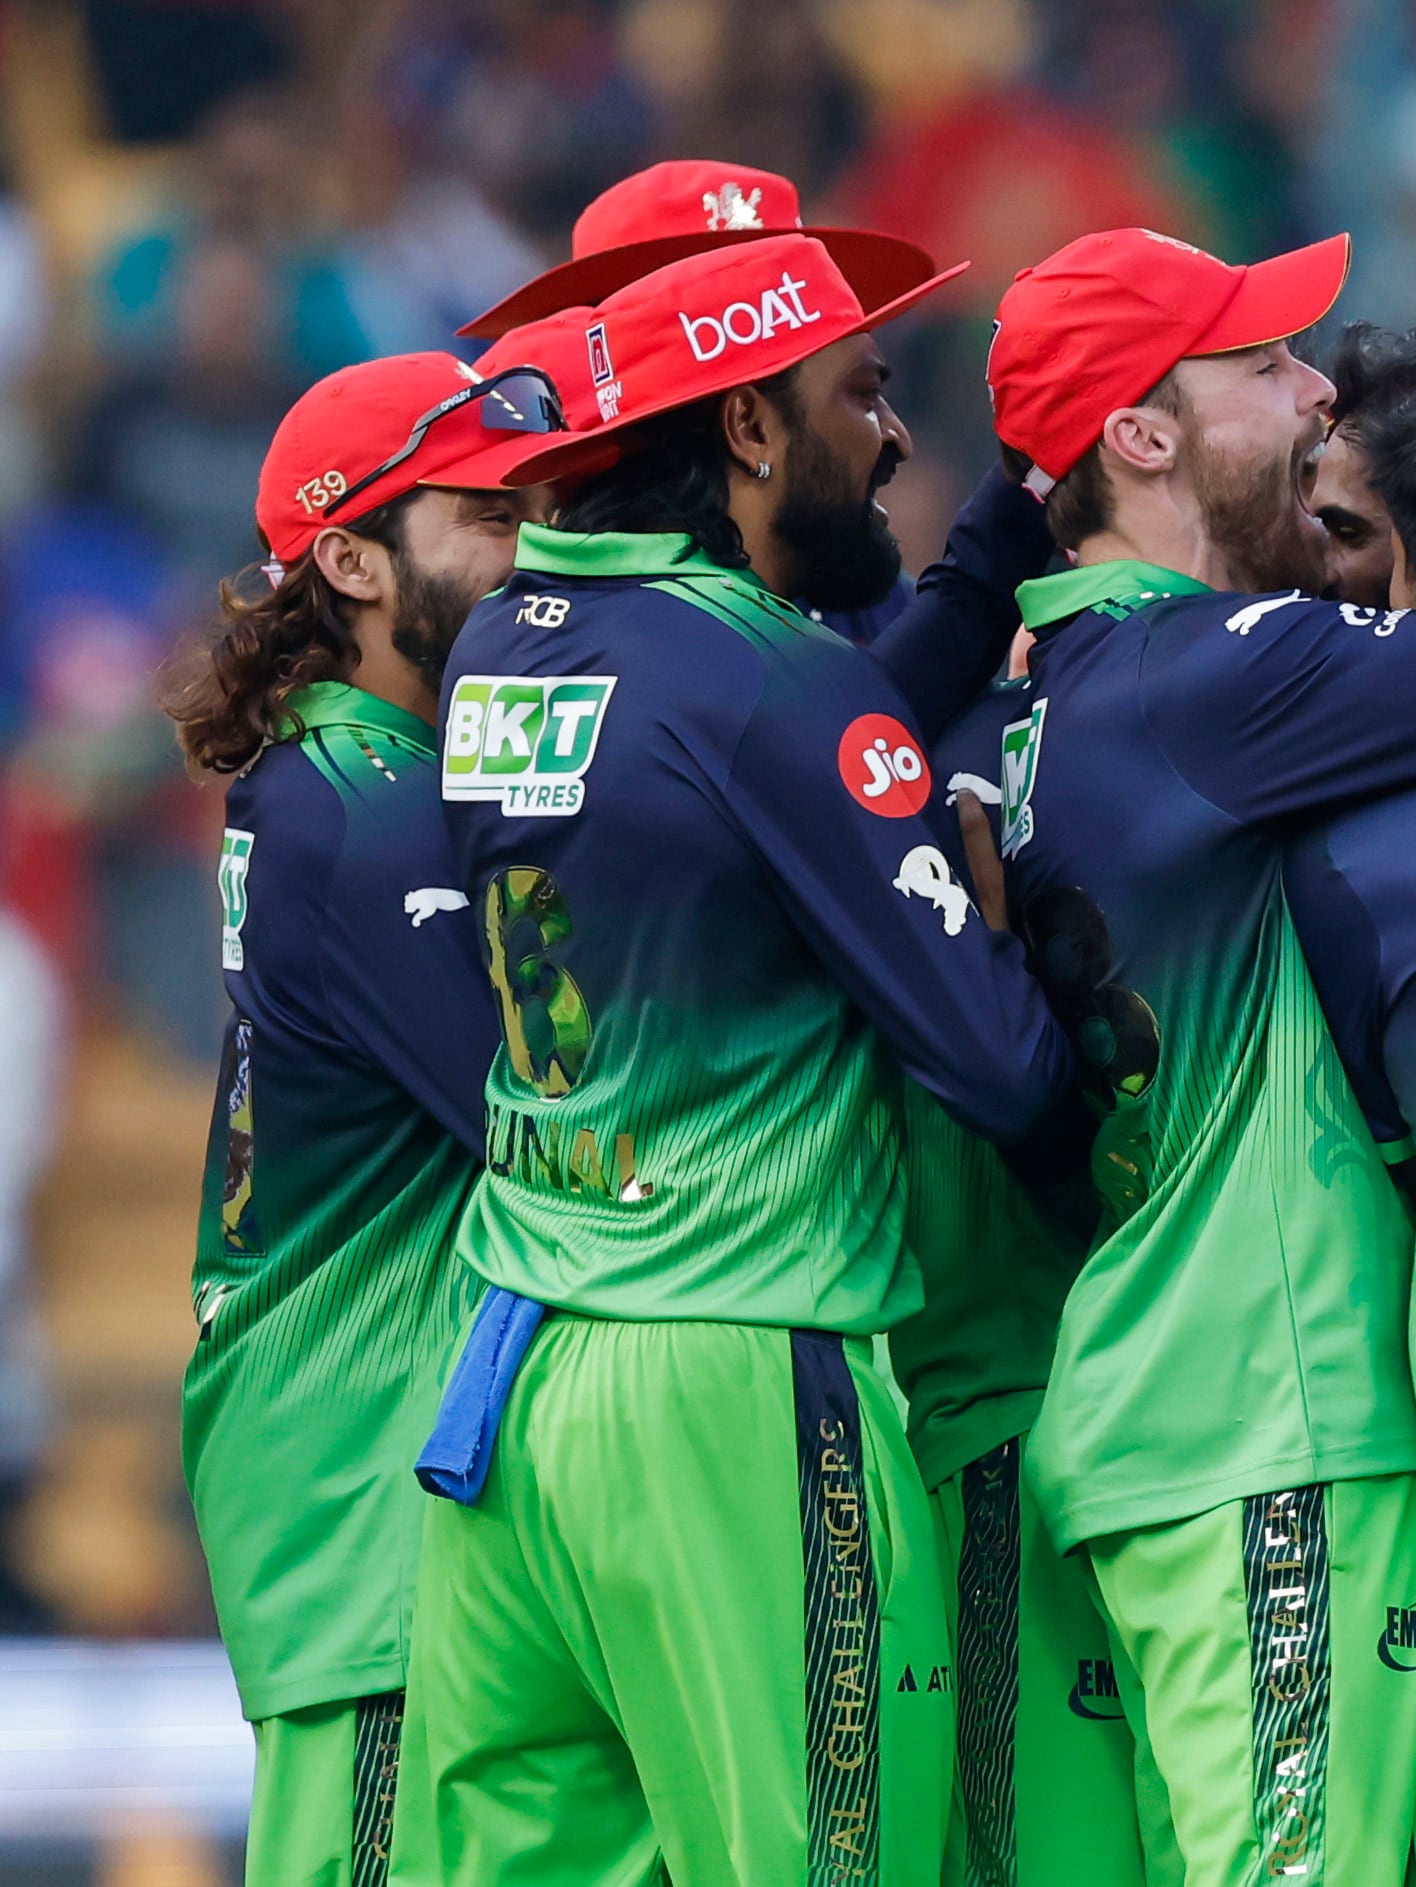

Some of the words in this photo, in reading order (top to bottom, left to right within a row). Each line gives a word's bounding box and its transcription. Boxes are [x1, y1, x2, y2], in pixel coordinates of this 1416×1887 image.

[296, 470, 347, 514] 139
[515, 595, 571, 628] RCB
[447, 699, 599, 758] BKT
[508, 785, 580, 808] TYRES
[484, 864, 592, 1103] 6
[819, 1417, 866, 1770] CHALLENGERS
[1268, 1721, 1309, 1877] ROYAL
